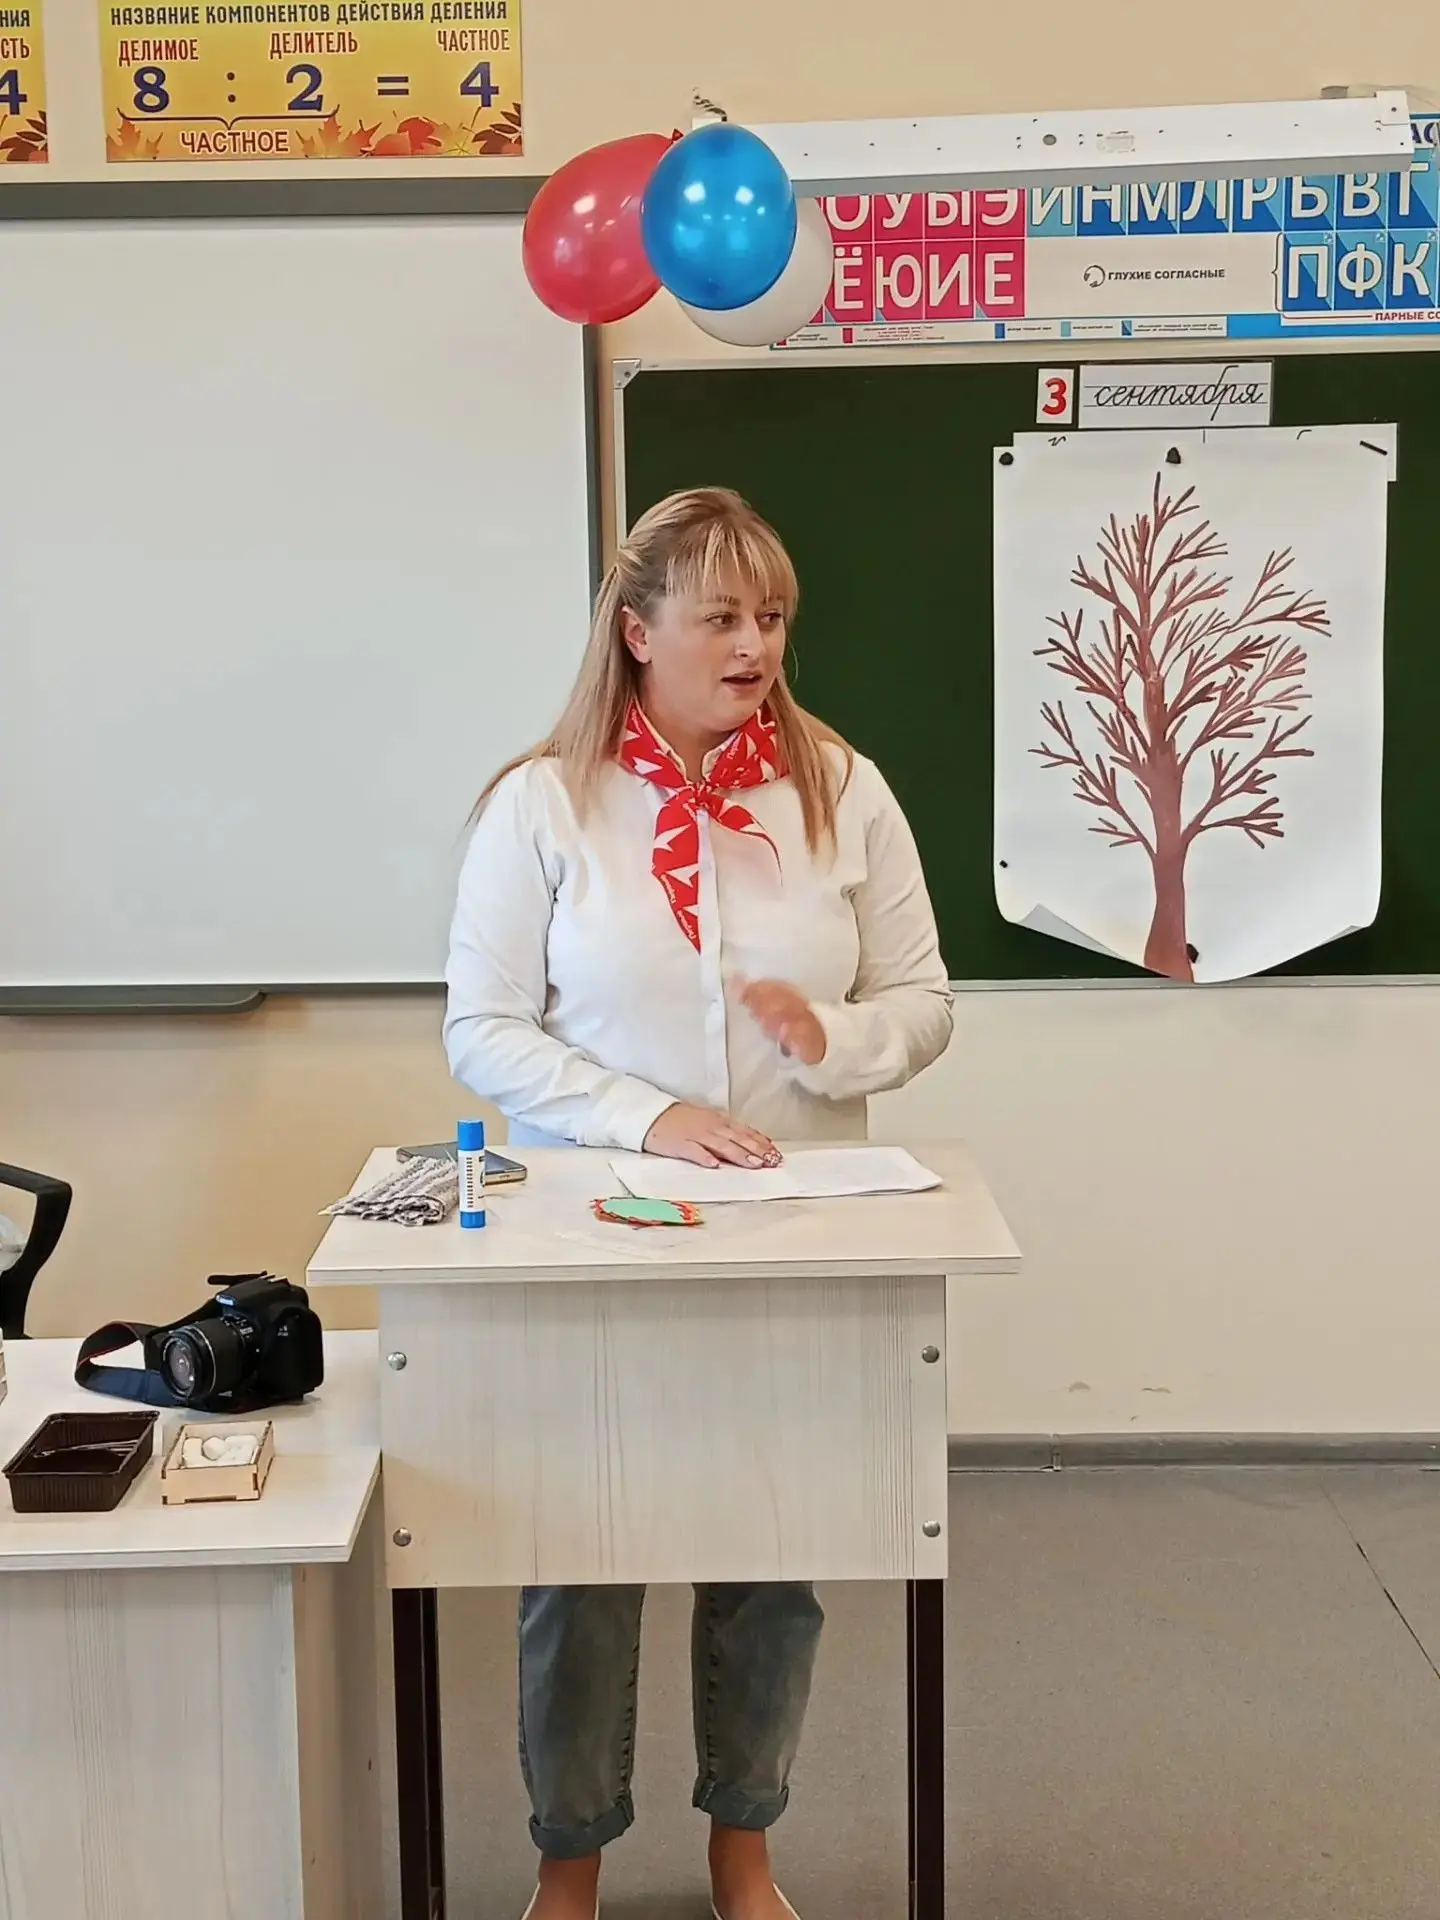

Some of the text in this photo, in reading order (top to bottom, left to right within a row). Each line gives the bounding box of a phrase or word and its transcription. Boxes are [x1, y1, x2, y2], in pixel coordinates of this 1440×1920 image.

[111, 0, 507, 25] НАЗВАНИЕ КОМПОНЕНТОВ ДЕЙСТВИЯ ДЕЛЕНИЯ
[118, 38, 199, 67] ДЕЛИМОЕ
[269, 31, 358, 59] ДЕЛИТЕЛЬ
[437, 29, 510, 51] ЧАСТНОЕ
[133, 66, 170, 113] 8
[285, 63, 324, 112] 2
[460, 61, 500, 108] 4
[181, 131, 289, 153] ЧАСТНОЕ
[1108, 268, 1225, 281] ГЛУХИЕ СОГЛАСНЫЕ
[1375, 311, 1424, 321] ПАРНЫЕ
[1041, 364, 1263, 421] 3 сентября
